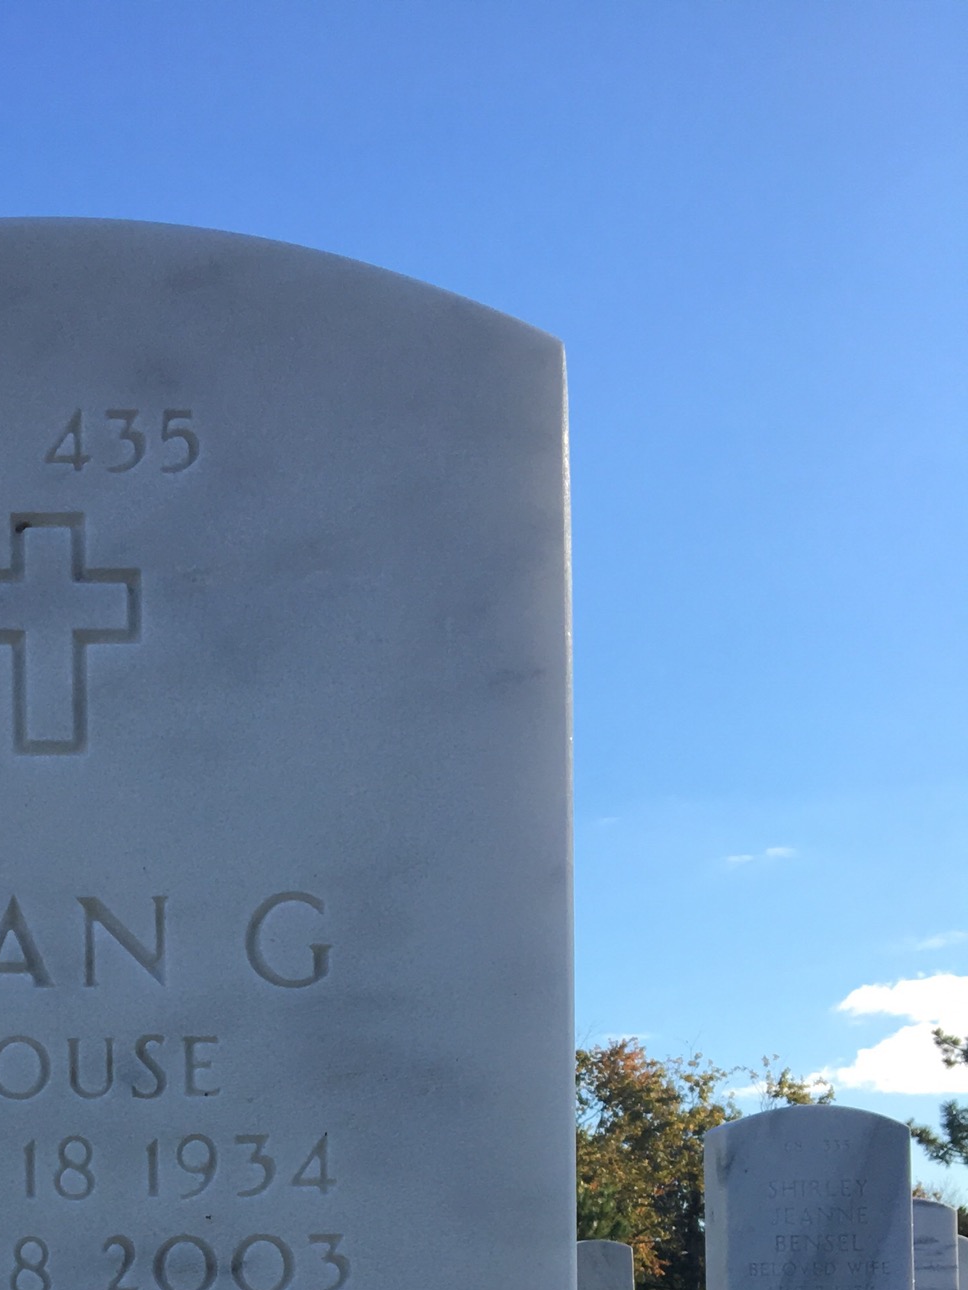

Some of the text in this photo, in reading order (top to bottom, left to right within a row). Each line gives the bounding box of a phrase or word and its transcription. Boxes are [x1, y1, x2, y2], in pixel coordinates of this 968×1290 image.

[44, 407, 200, 473] 435
[244, 890, 333, 988] G
[22, 1134, 97, 1200] 18
[146, 1132, 337, 1200] 1934
[767, 1179, 869, 1199] SHIRLEY
[769, 1206, 869, 1226] JEANNE
[774, 1234, 864, 1253] BENSEL
[747, 1260, 892, 1277] BELOVED WIFE
